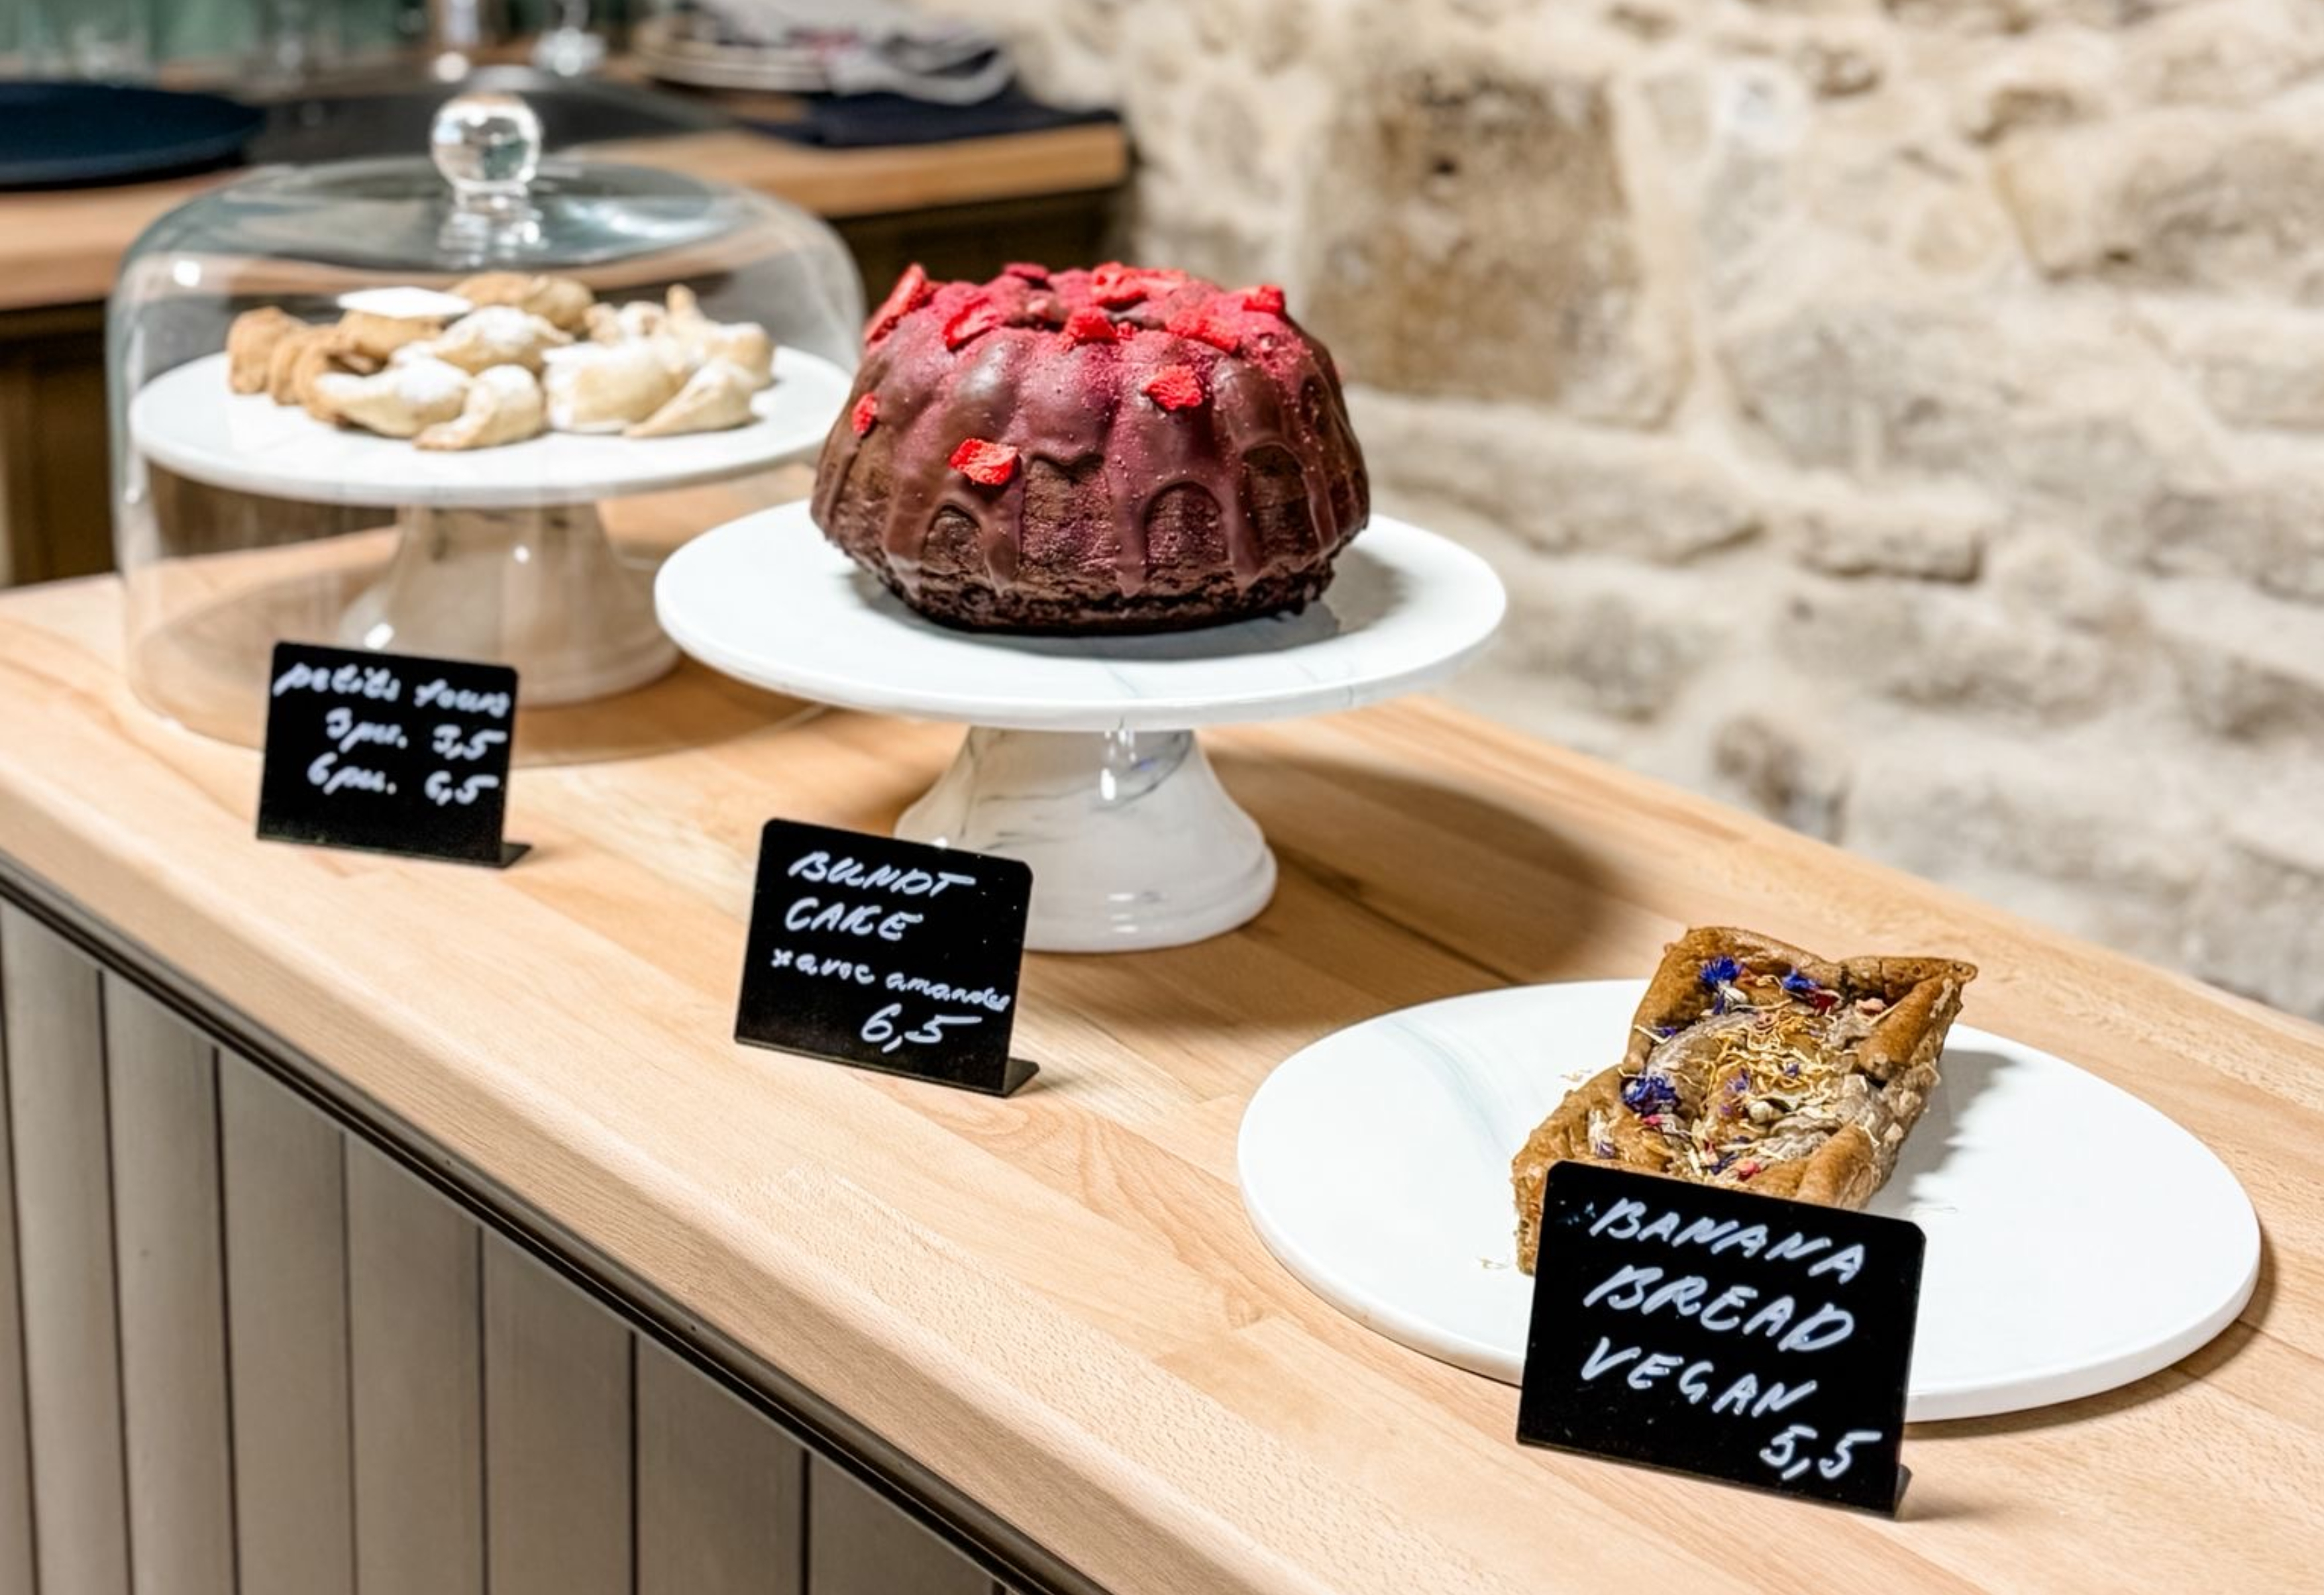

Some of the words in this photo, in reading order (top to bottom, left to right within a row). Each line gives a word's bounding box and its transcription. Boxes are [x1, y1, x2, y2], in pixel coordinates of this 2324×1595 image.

[272, 662, 401, 701] petits
[433, 724, 507, 760] 3,5
[425, 770, 500, 806] 6,5
[787, 851, 977, 898] BUNDT
[784, 896, 924, 941] CAKE
[861, 1002, 983, 1053] 6,5
[1589, 1197, 1865, 1284] BANANA
[1583, 1264, 1854, 1352] BREAD
[1581, 1336, 1818, 1418] VEGAN
[1759, 1424, 1883, 1481] 5,5
